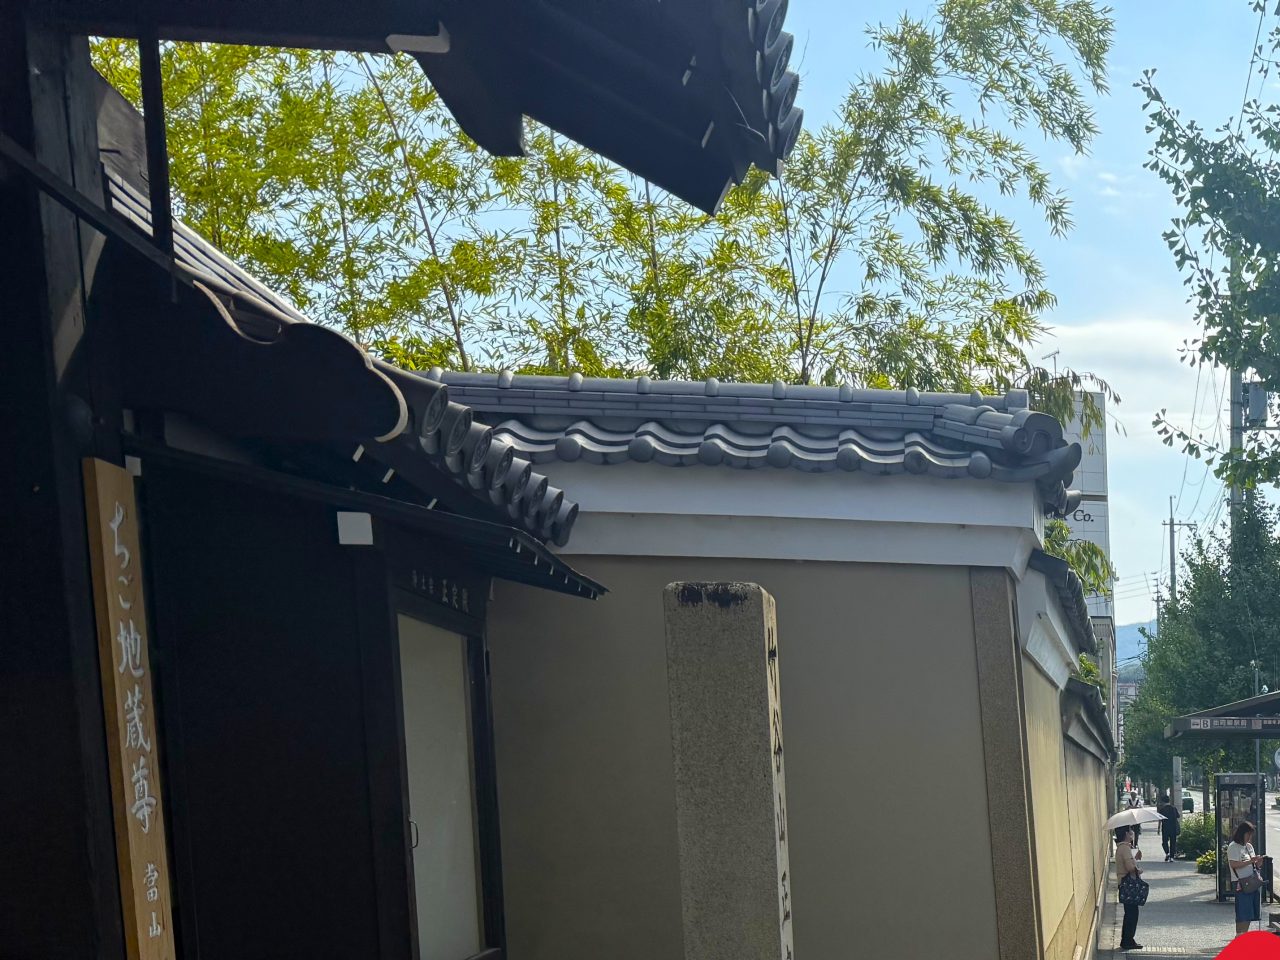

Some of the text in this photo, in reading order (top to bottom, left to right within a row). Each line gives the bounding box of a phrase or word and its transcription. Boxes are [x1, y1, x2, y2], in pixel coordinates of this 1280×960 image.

[1073, 509, 1094, 522] Co.
[109, 500, 157, 834] ちご地蔵尊
